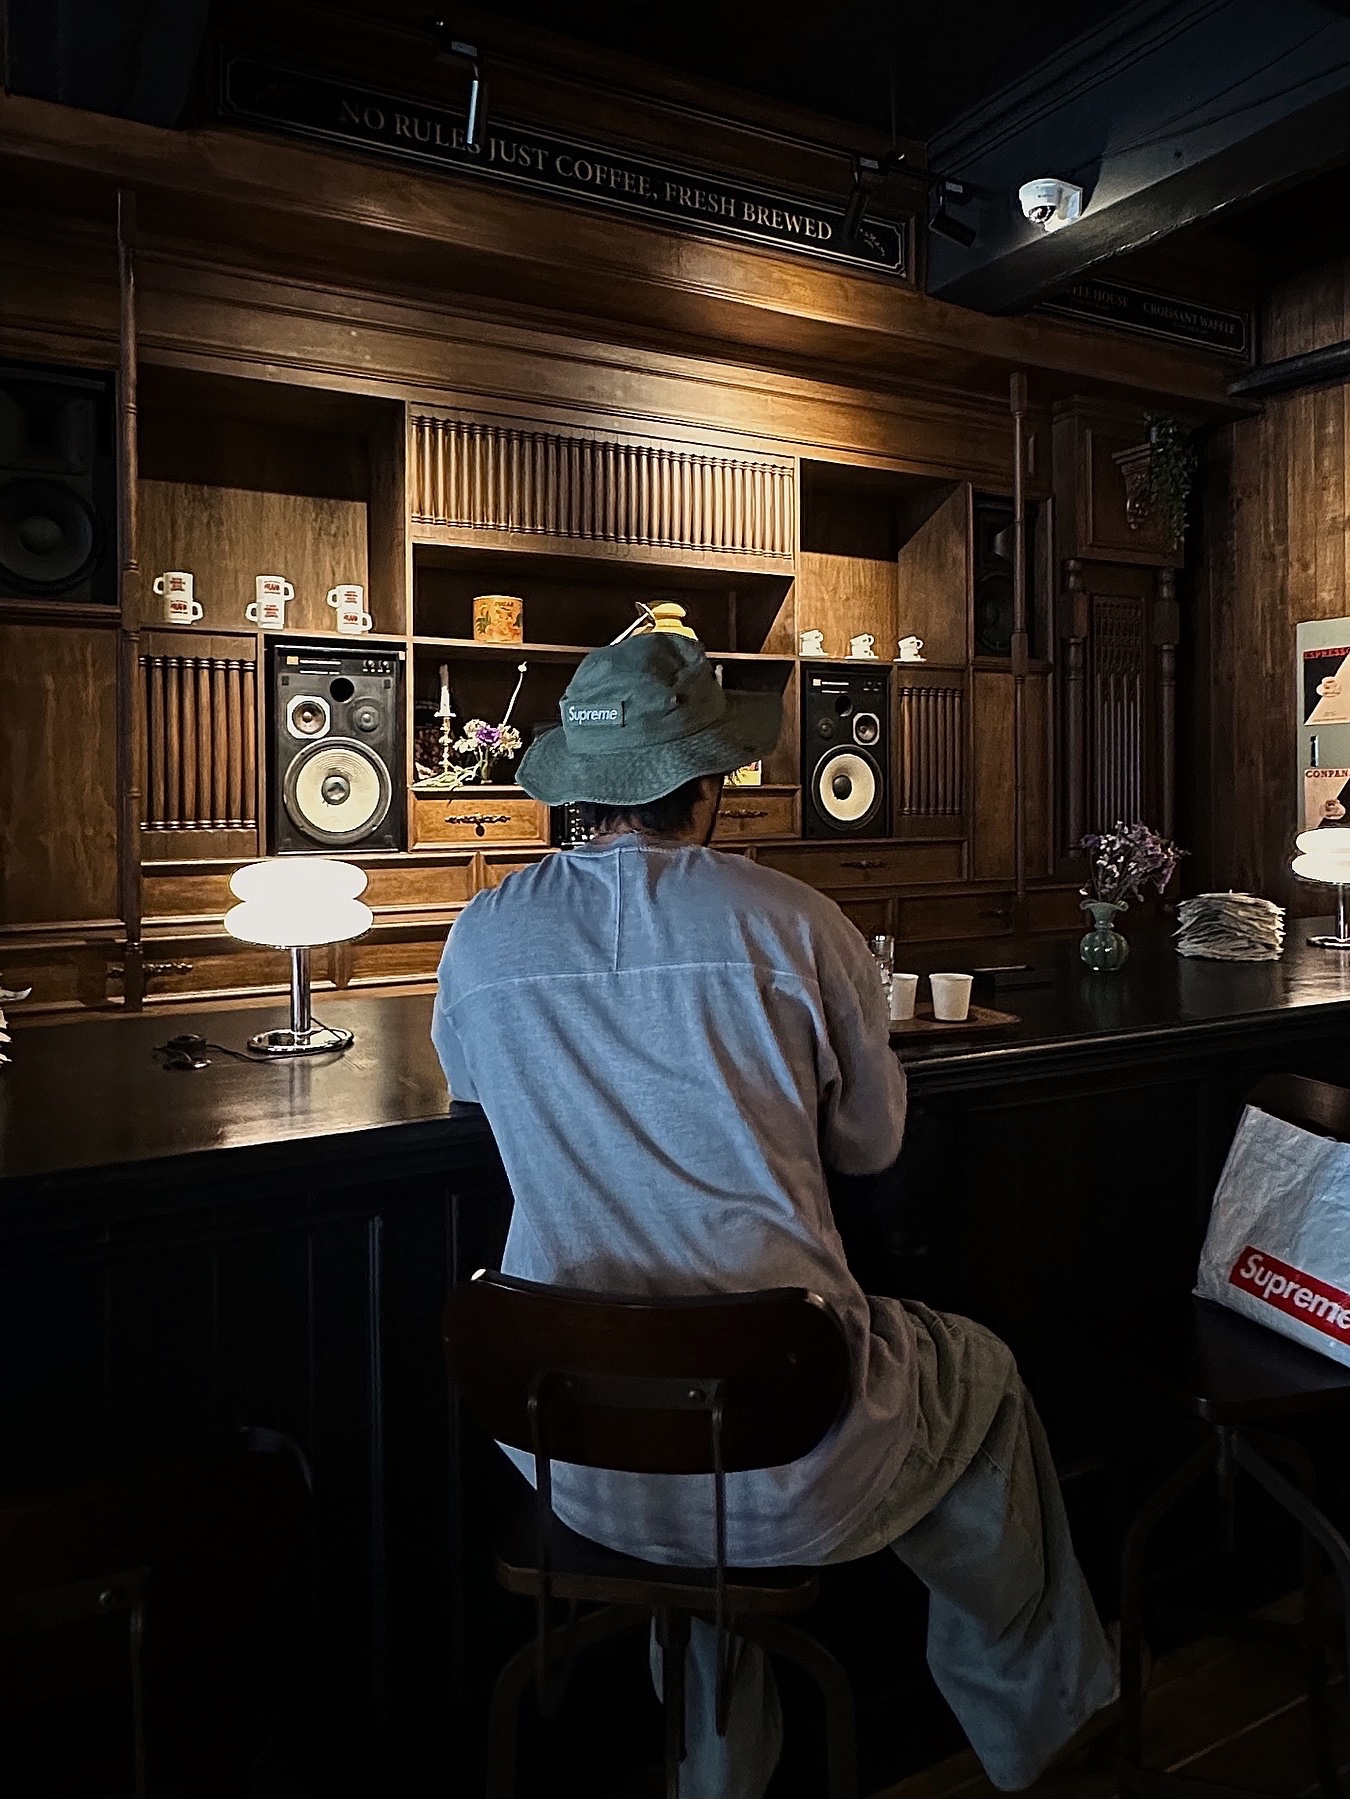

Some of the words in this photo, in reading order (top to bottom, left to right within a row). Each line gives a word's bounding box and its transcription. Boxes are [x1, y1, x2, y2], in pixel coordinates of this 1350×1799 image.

[339, 99, 385, 130] NO
[488, 137, 549, 171] JUST
[555, 154, 660, 200] COFFEE,
[664, 182, 736, 218] FRESH
[741, 201, 833, 240] BREWED
[1093, 288, 1130, 308] HOUSE
[568, 705, 618, 725] Supreme
[1305, 769, 1350, 779] CONPAN
[1239, 1253, 1350, 1330] Supreme
